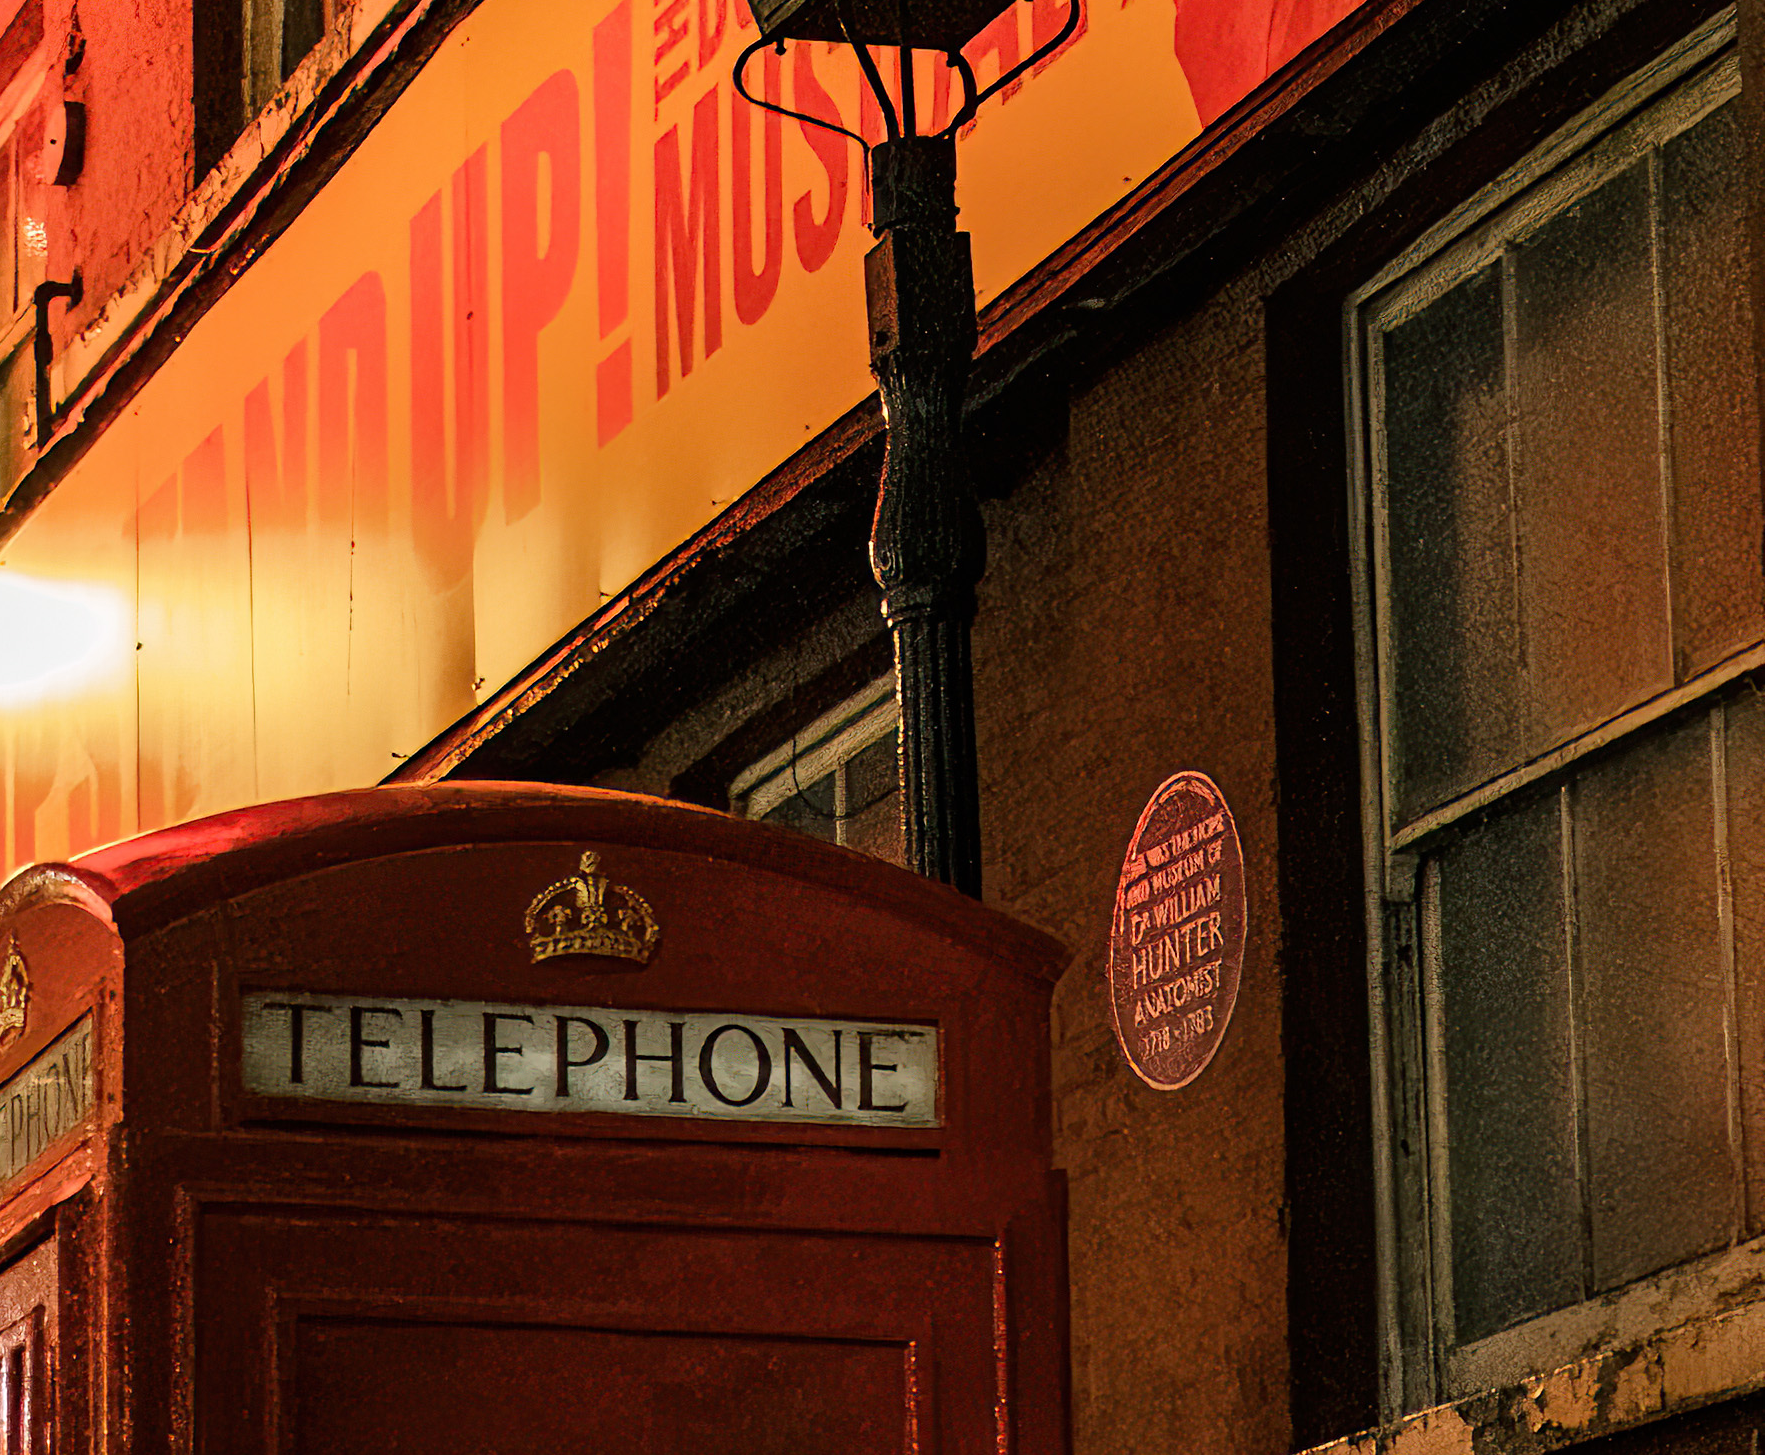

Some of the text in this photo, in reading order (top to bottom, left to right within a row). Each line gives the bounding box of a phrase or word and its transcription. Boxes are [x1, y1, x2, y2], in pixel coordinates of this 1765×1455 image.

[1153, 873, 1221, 928] WILLIAM
[1132, 911, 1224, 990] HUNTER
[1134, 957, 1223, 1027] ANATOMIST
[264, 1002, 924, 1113] TELEPHONE
